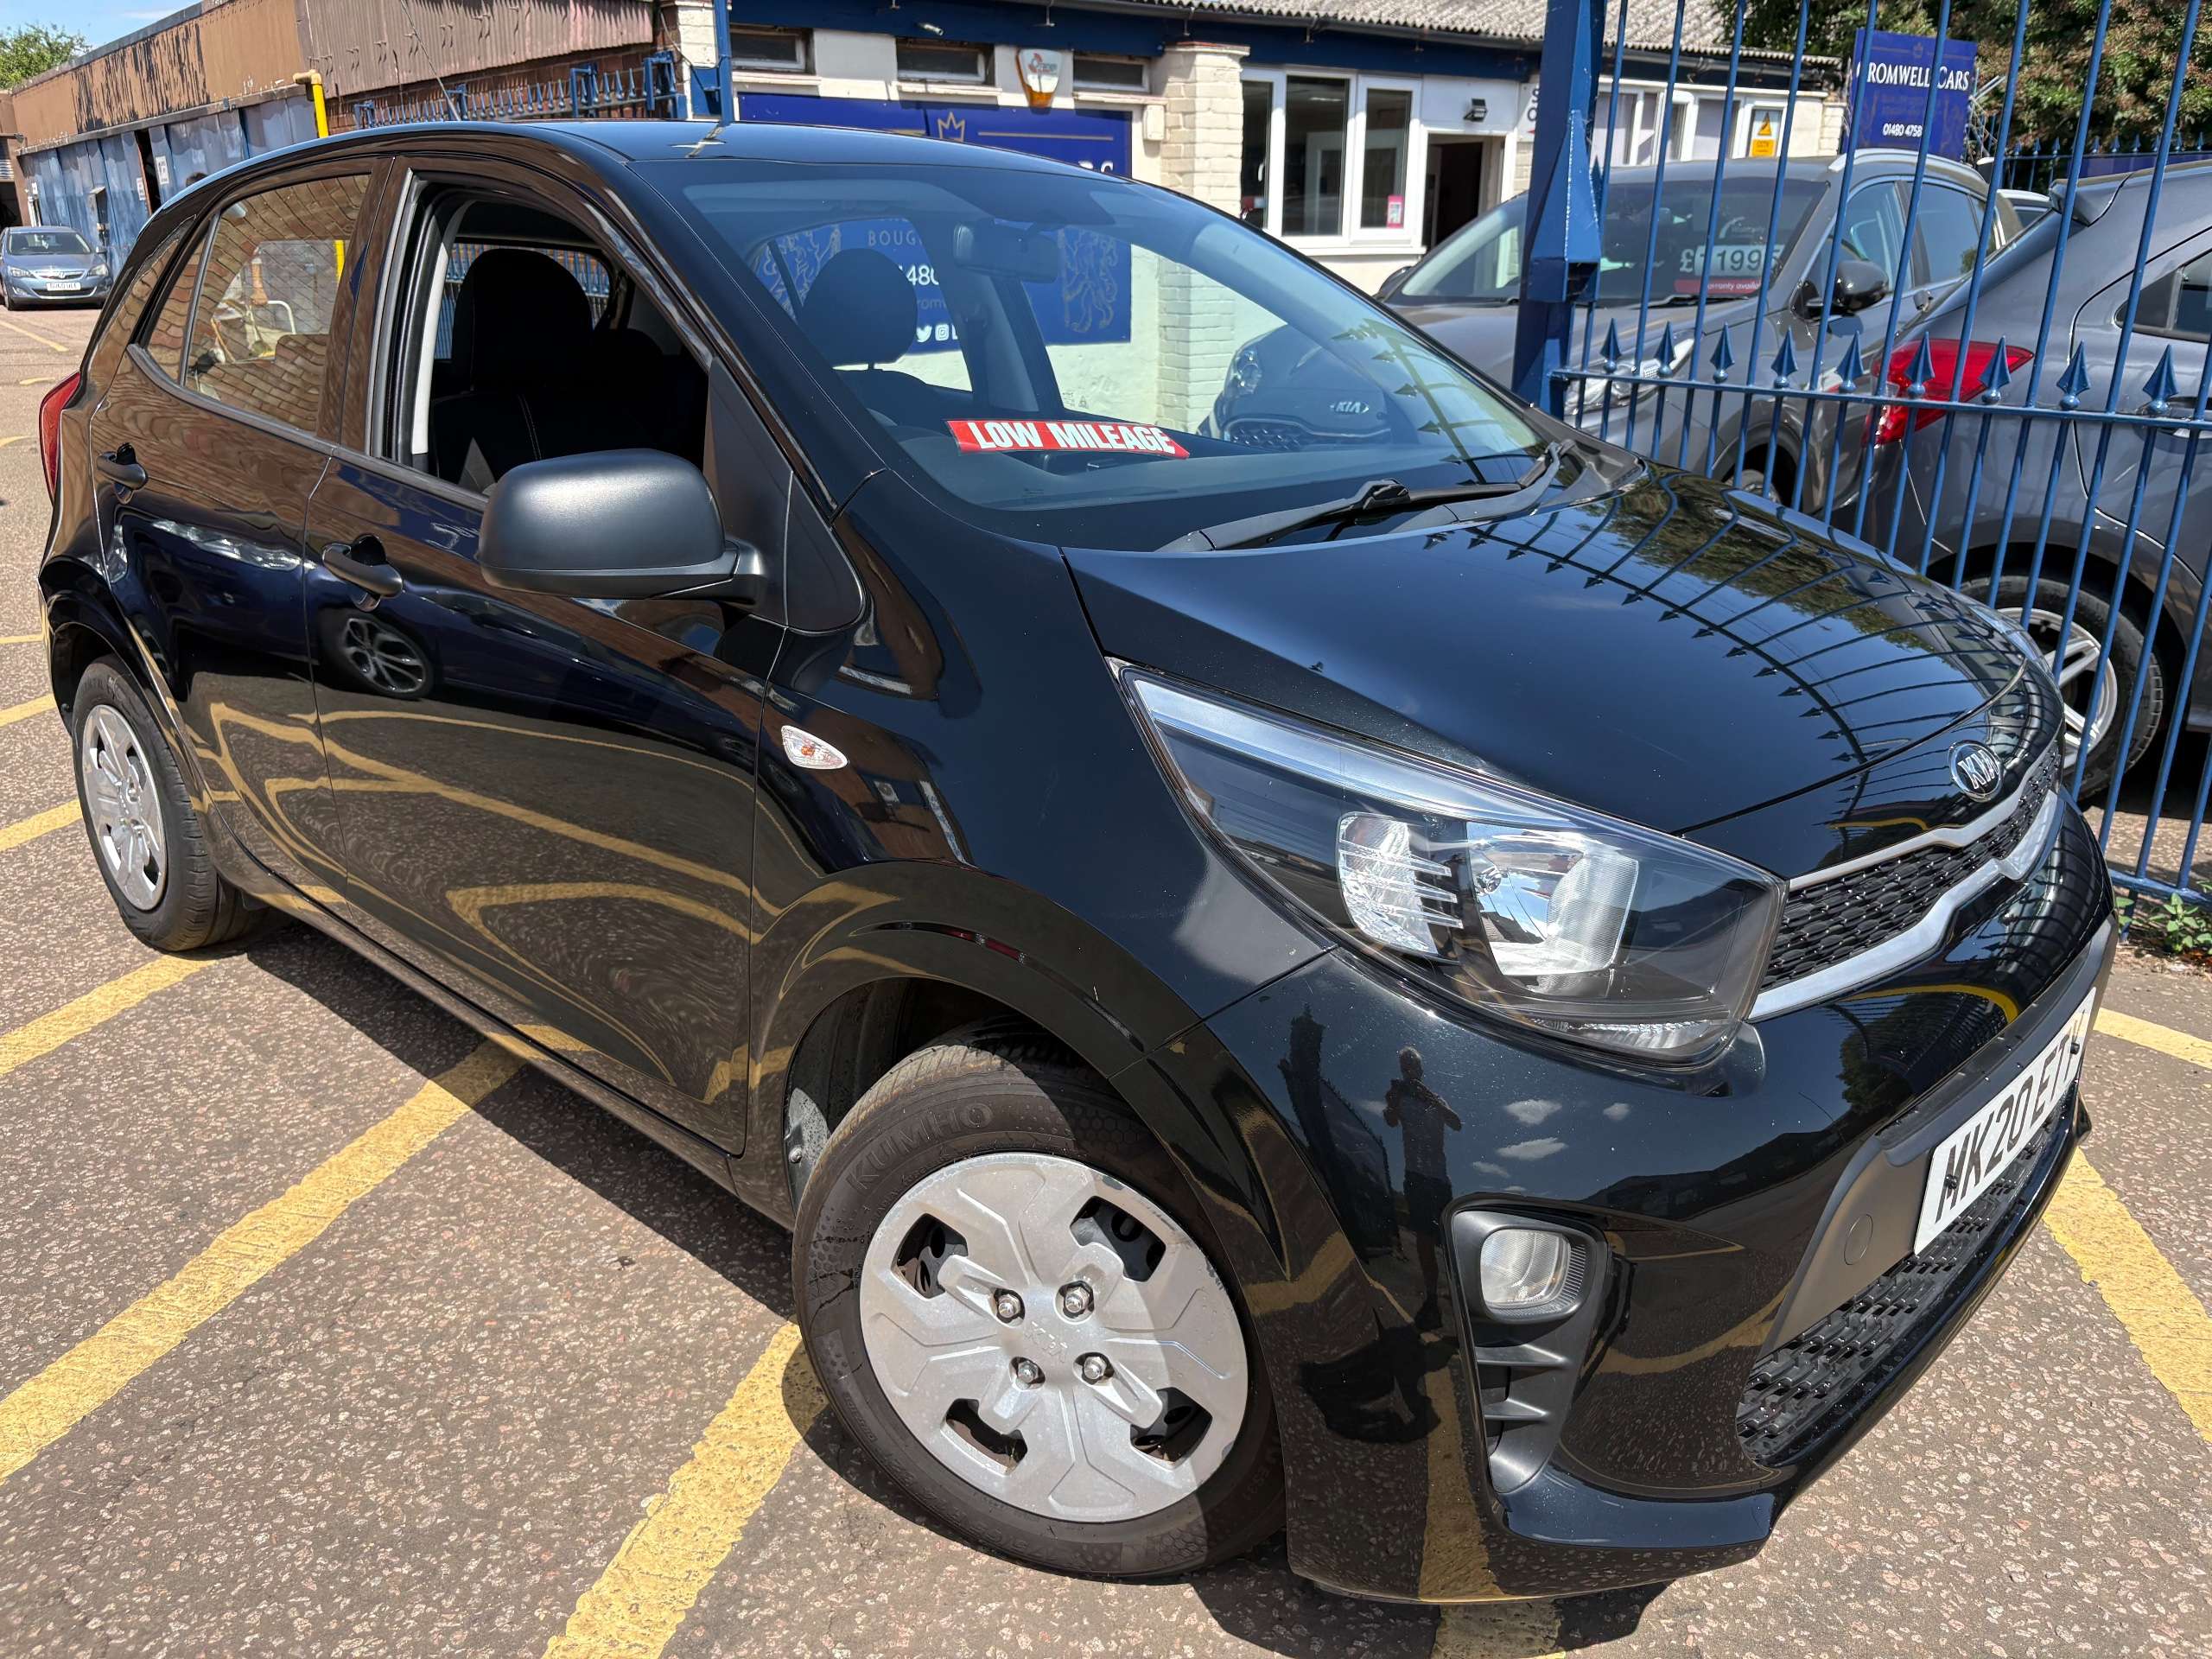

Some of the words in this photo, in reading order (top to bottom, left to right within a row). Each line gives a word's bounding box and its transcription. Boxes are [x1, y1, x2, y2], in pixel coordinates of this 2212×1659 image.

[1937, 67, 1970, 91] CARS
[1883, 124, 1904, 137] 01480
[1905, 124, 1923, 137] 4758
[868, 229, 922, 246] BOUG
[1680, 248, 1781, 272] £199
[1336, 401, 1361, 413] KIA
[967, 422, 1044, 448] LOW
[1047, 423, 1176, 454] MILEAGE
[1957, 749, 1999, 789] KIA
[847, 1103, 993, 1190] KUMHO
